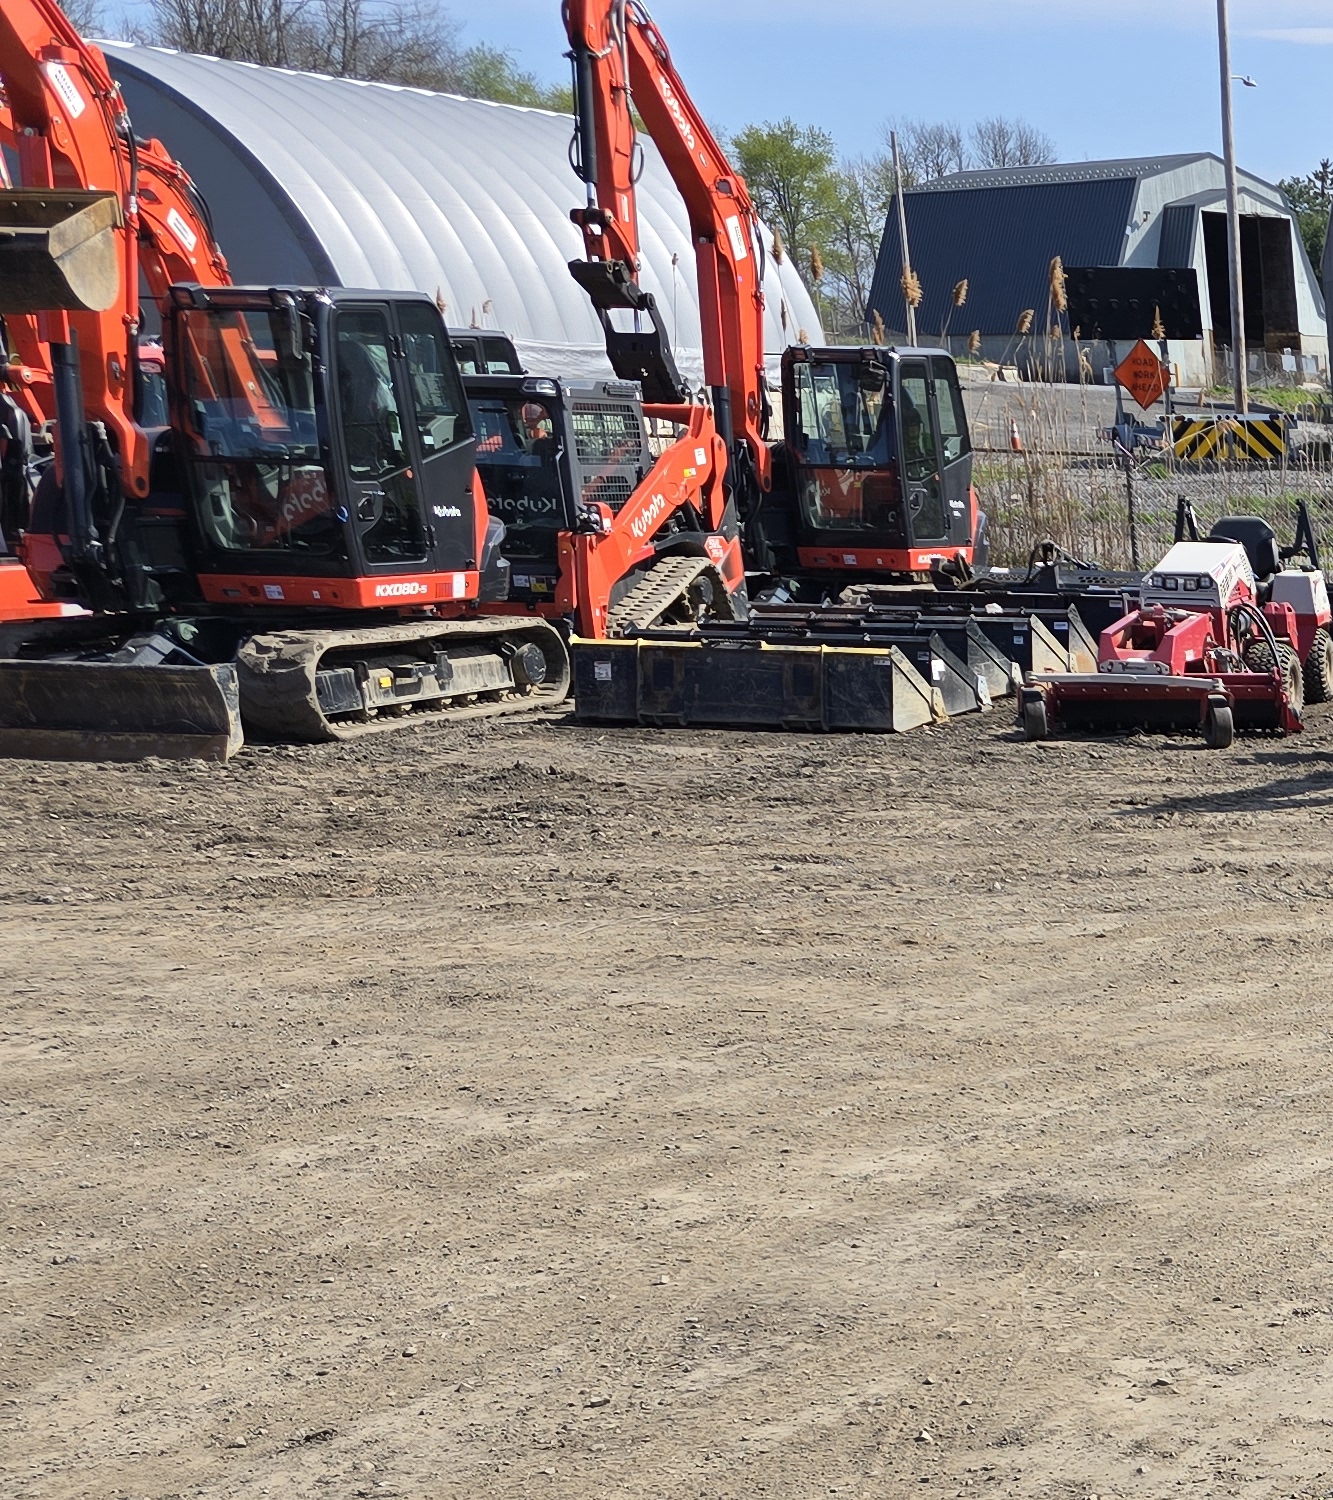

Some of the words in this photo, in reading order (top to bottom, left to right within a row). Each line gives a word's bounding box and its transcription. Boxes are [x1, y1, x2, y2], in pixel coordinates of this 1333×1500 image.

[660, 75, 695, 150] Kubota
[1131, 358, 1154, 366] ROAD
[1133, 370, 1156, 379] WORK
[1131, 383, 1160, 392] AHEAD
[631, 493, 666, 537] Kubota
